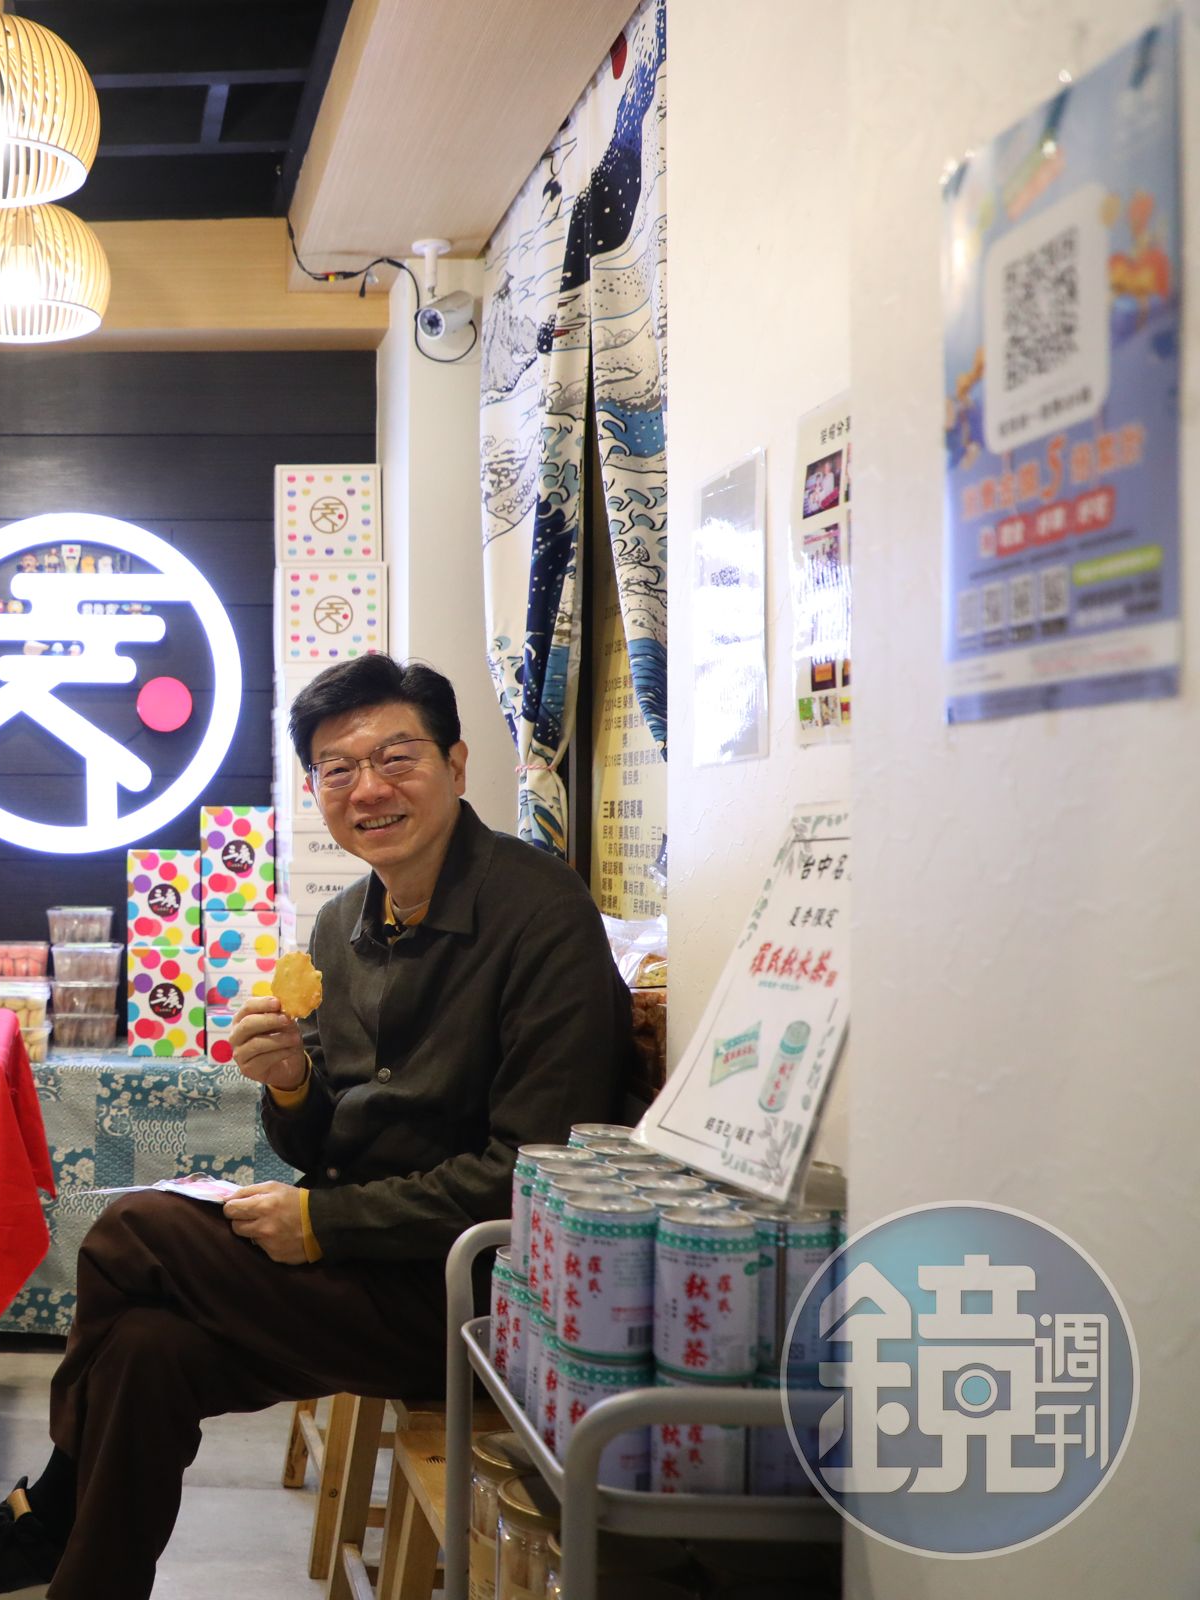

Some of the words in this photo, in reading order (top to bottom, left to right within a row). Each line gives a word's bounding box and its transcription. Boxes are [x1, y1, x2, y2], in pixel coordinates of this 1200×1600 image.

[800, 855, 852, 882] 台中名
[787, 906, 839, 929] 夏季限定
[563, 1251, 583, 1343] 秋水茶
[682, 1271, 711, 1368] 秋水茶
